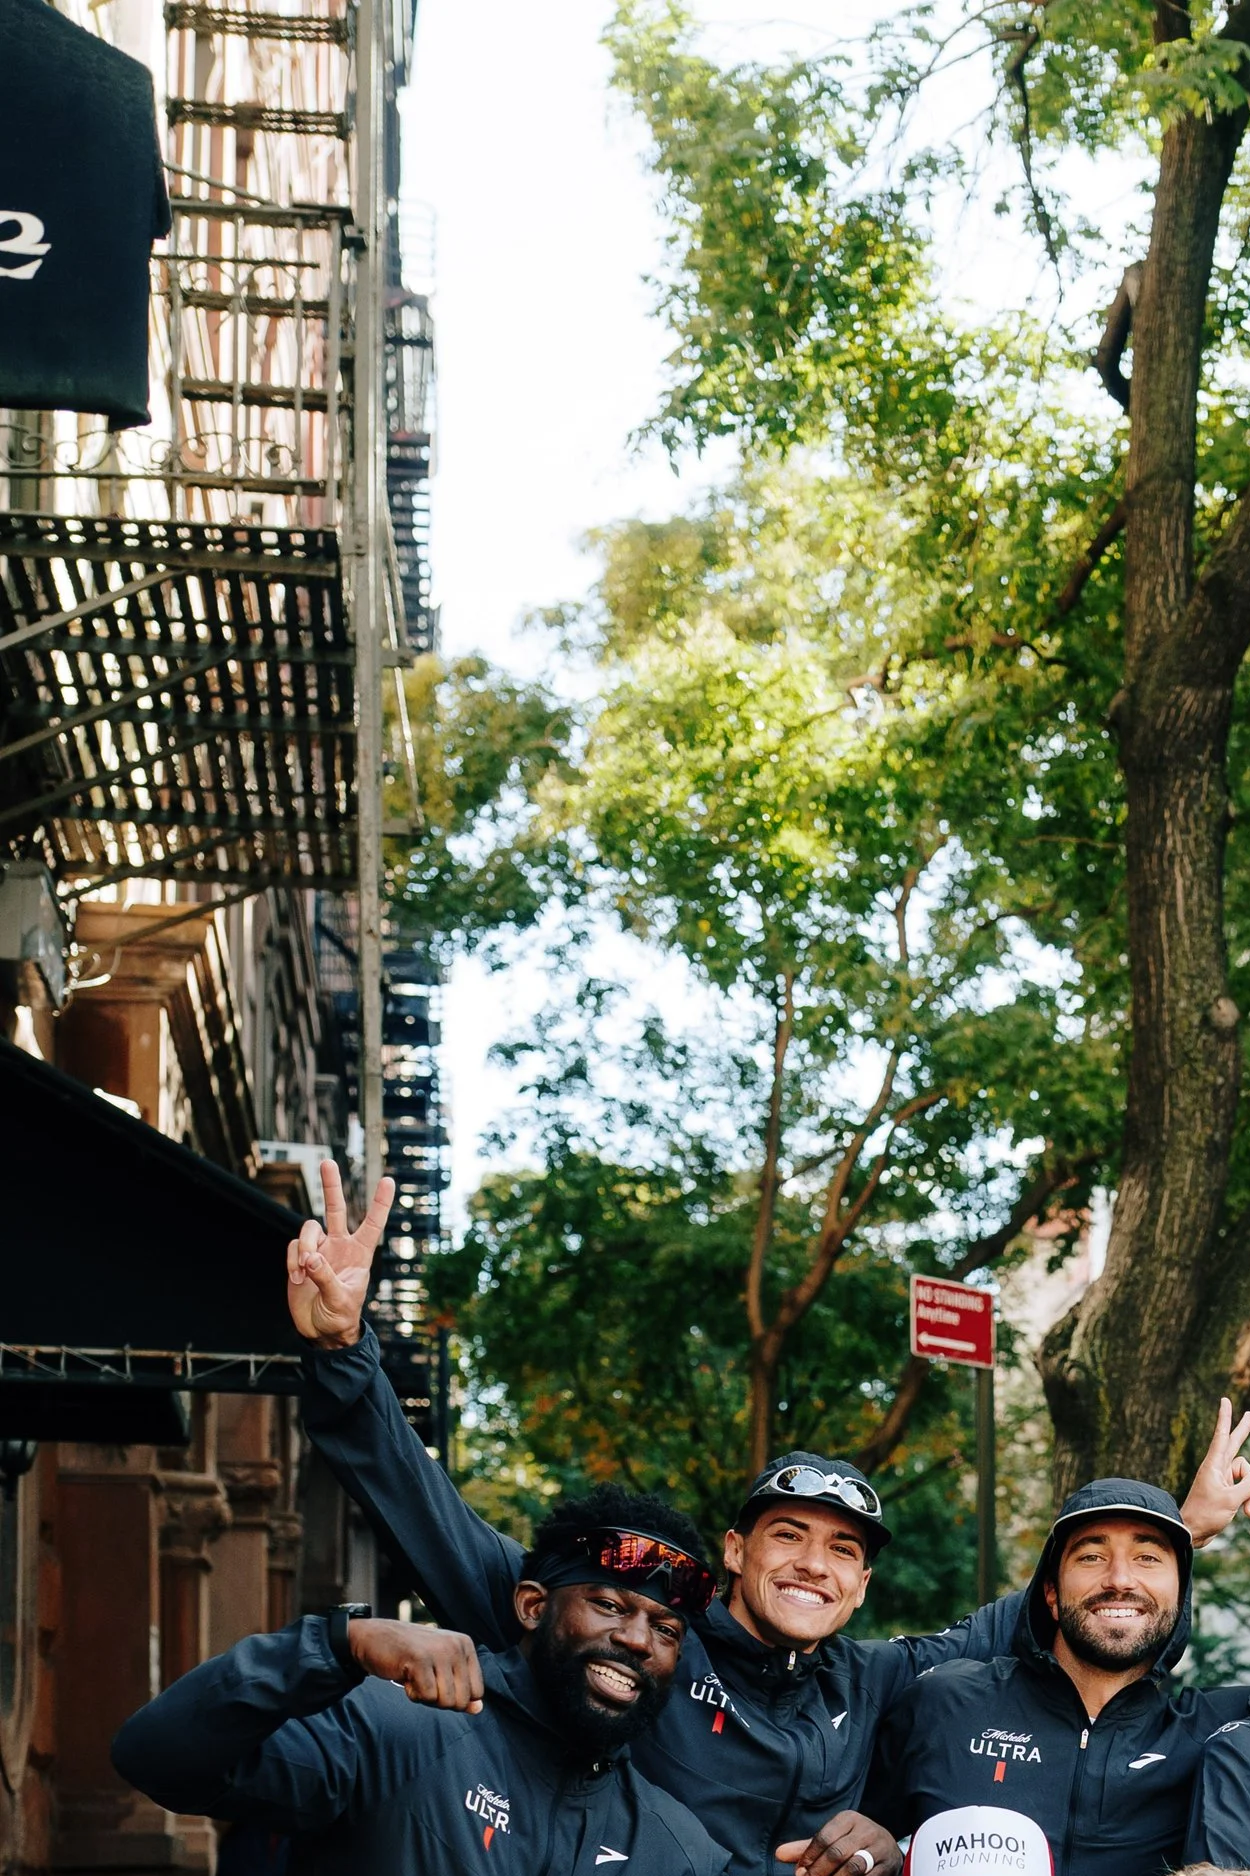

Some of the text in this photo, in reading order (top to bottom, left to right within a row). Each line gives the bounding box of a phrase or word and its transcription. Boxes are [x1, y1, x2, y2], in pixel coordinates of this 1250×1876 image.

[916, 1285, 985, 1313] NO STANDING
[917, 1303, 960, 1327] Anytime
[690, 1681, 750, 1729] ULT
[981, 1728, 1033, 1744] Michelob
[969, 1738, 1042, 1763] ULTRA
[477, 1783, 510, 1811] Michelo
[465, 1790, 511, 1835] ULTR
[935, 1832, 1026, 1857] WAHOO!
[936, 1851, 1026, 1873] RUNNING
